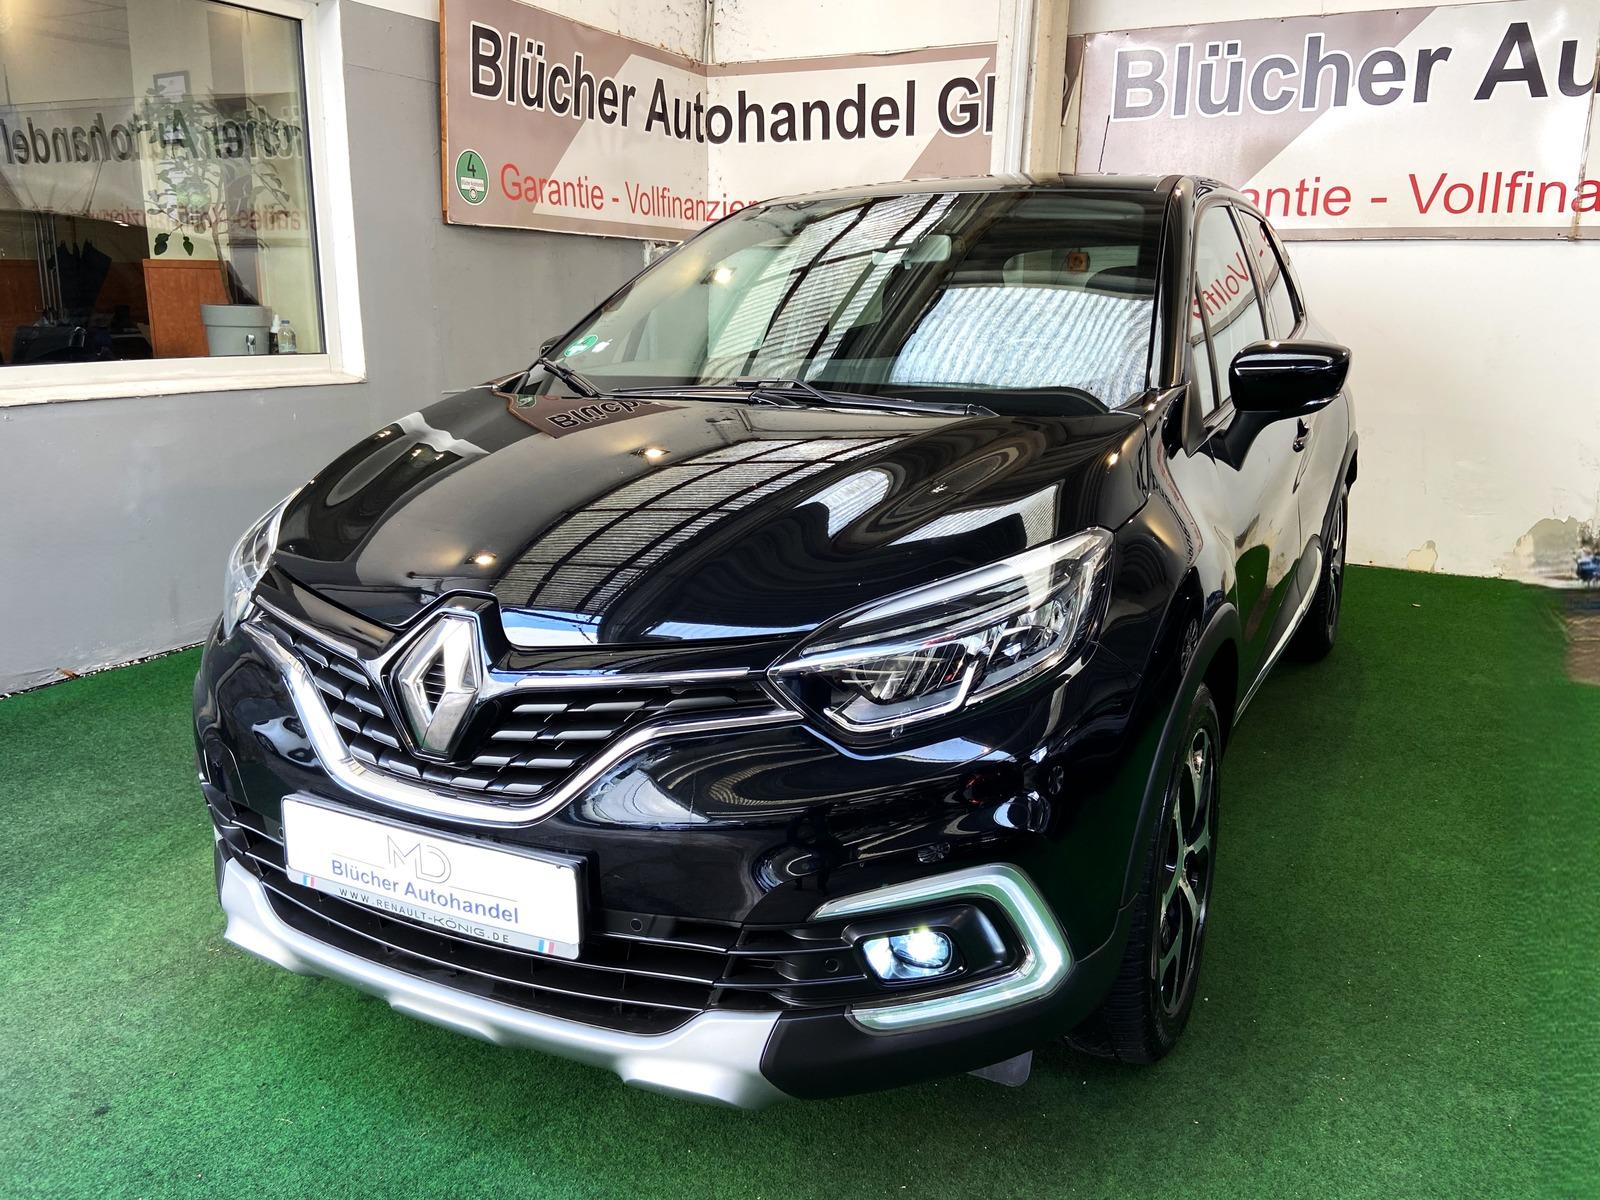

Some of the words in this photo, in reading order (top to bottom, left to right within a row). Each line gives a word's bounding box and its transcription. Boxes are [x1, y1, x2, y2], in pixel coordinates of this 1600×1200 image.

[471, 22, 637, 128] Blücher
[645, 78, 916, 145] Autohandel
[1112, 33, 1453, 120] Blücher
[466, 153, 477, 177] 4
[500, 163, 604, 211] Garantie
[331, 859, 399, 893] Blücher
[404, 881, 519, 924] Autohandel
